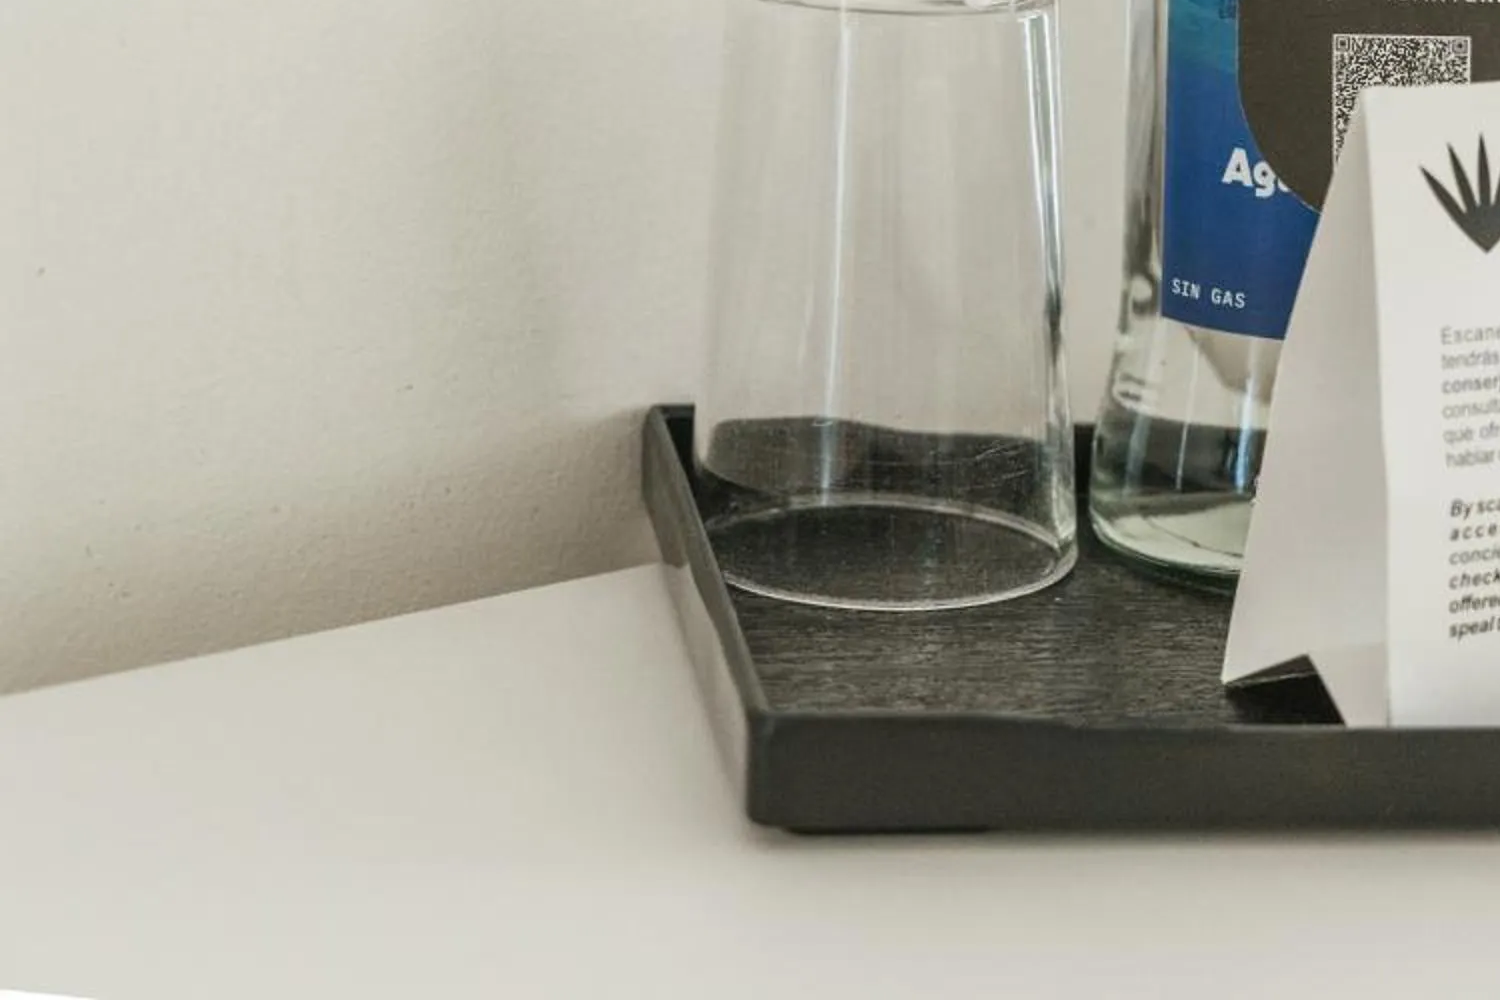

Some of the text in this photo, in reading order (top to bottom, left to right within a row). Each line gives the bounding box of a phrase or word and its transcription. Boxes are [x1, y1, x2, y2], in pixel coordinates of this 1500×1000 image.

[1221, 147, 1291, 198] Ag
[1171, 278, 1246, 309] SIN GAS
[1442, 427, 1474, 446] que
[1449, 498, 1473, 520] By
